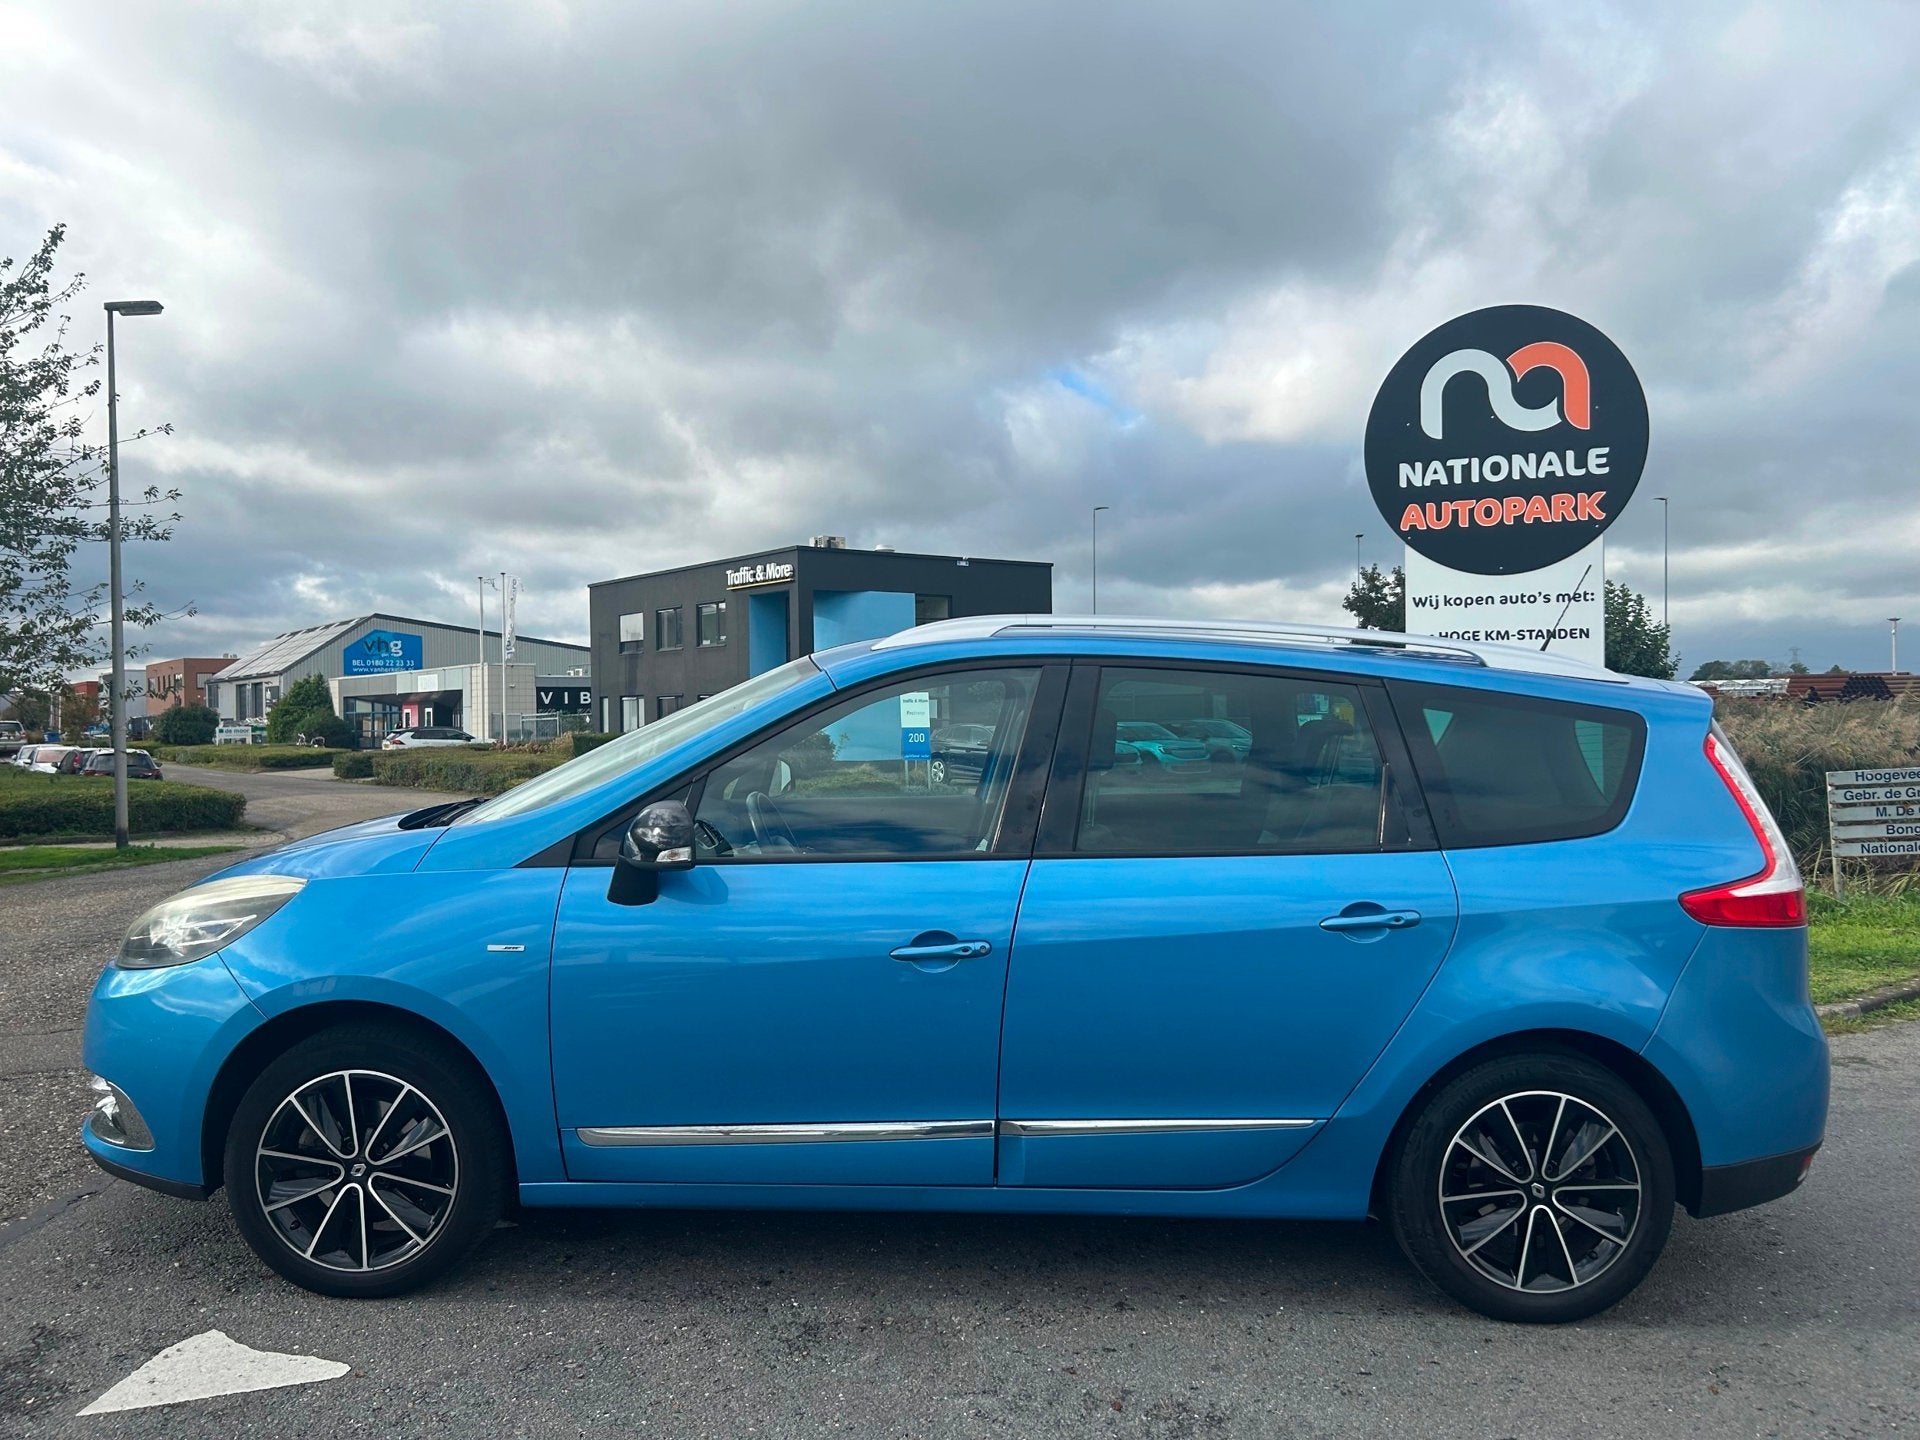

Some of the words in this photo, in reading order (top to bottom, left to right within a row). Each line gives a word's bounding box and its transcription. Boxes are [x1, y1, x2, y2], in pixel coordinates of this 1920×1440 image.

[1398, 447, 1610, 488] NATIONALE
[1400, 491, 1607, 531] AUTOPARK
[726, 566, 754, 585] Traffic
[756, 565, 764, 581] &
[766, 562, 793, 579] More
[1412, 594, 1439, 610] Wij
[1444, 594, 1495, 608] kopen
[1555, 590, 1595, 603] met:
[1439, 630, 1480, 641] HOGE
[1485, 628, 1590, 641] KM-STANDEN
[364, 637, 403, 657] vhg
[352, 659, 365, 667] BEL
[385, 659, 394, 667] 22
[908, 733, 925, 743] 200
[1843, 790, 1880, 801] Gebr.
[1884, 788, 1902, 799] de
[1876, 807, 1891, 817] M.
[1896, 806, 1914, 816] De
[1861, 841, 1920, 854] National
